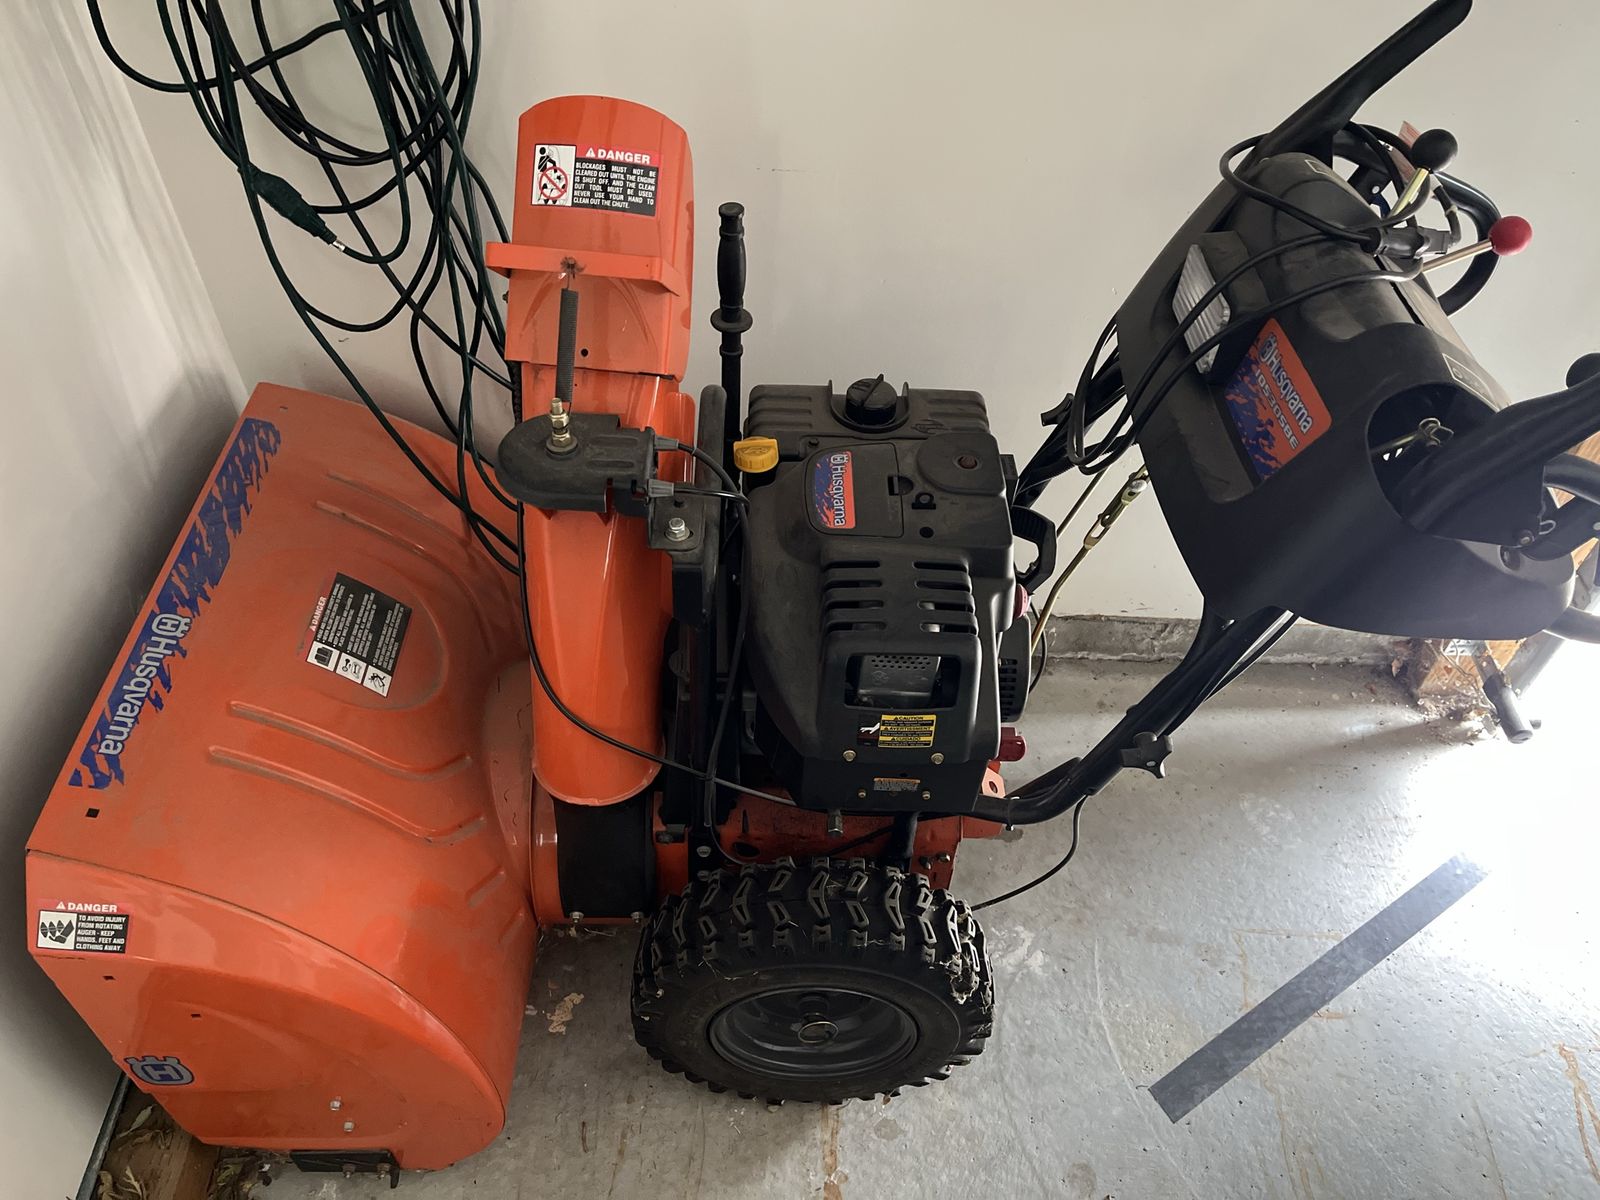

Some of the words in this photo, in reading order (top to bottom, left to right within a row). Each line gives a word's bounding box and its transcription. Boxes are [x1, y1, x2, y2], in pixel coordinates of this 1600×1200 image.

[598, 149, 650, 164] DANGER
[576, 162, 606, 170] BLOCKAGES
[610, 172, 625, 180] UNTIL
[637, 176, 656, 184] ENGINE
[638, 183, 656, 192] CLEAN
[1267, 347, 1313, 434] Husqvarna
[830, 465, 846, 526] Husqvarna
[312, 596, 327, 624] DANGER
[98, 636, 177, 756] Husqvarna
[68, 902, 117, 912] DANGER
